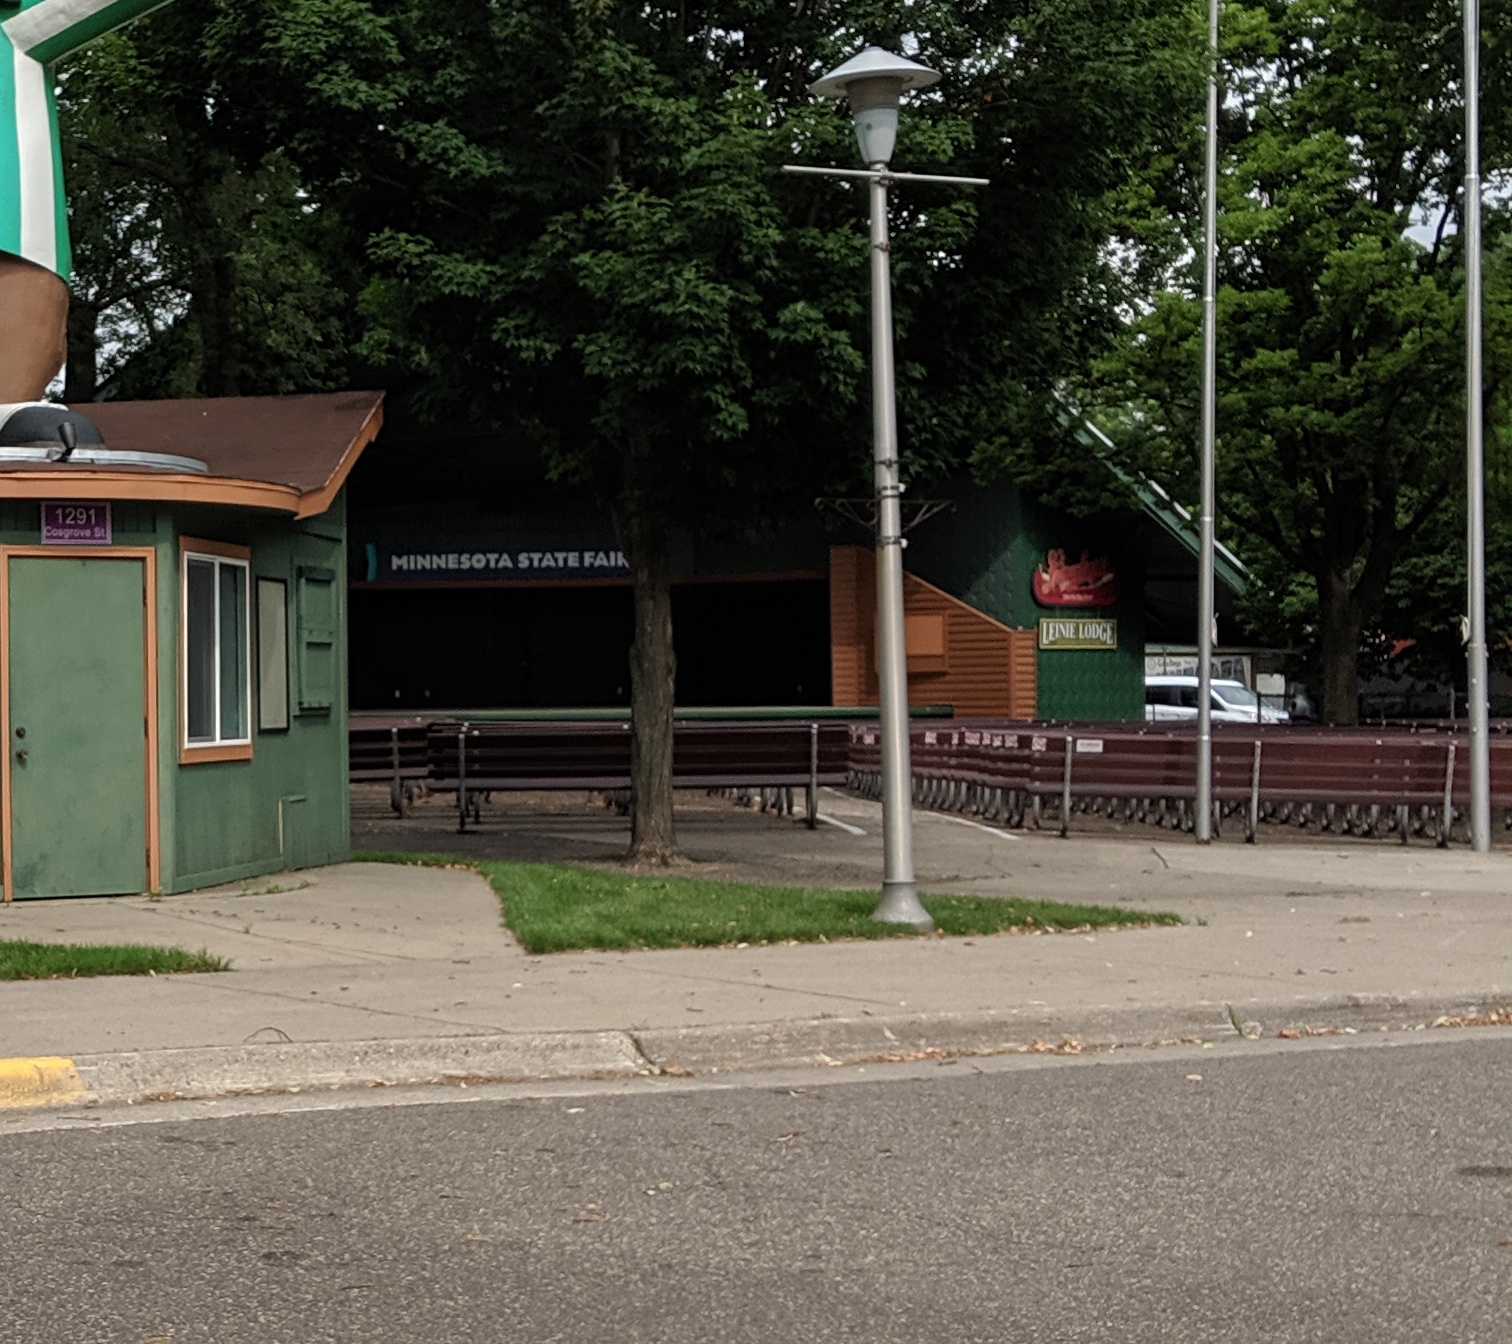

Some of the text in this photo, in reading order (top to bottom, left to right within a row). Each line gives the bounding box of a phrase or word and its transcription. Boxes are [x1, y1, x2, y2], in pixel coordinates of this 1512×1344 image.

[55, 507, 96, 525] 1291
[44, 525, 92, 539] Cosgrove
[391, 552, 513, 571] MINNESOTA
[517, 551, 580, 570] STATE
[1042, 621, 1114, 645] LEINIE LODGE
